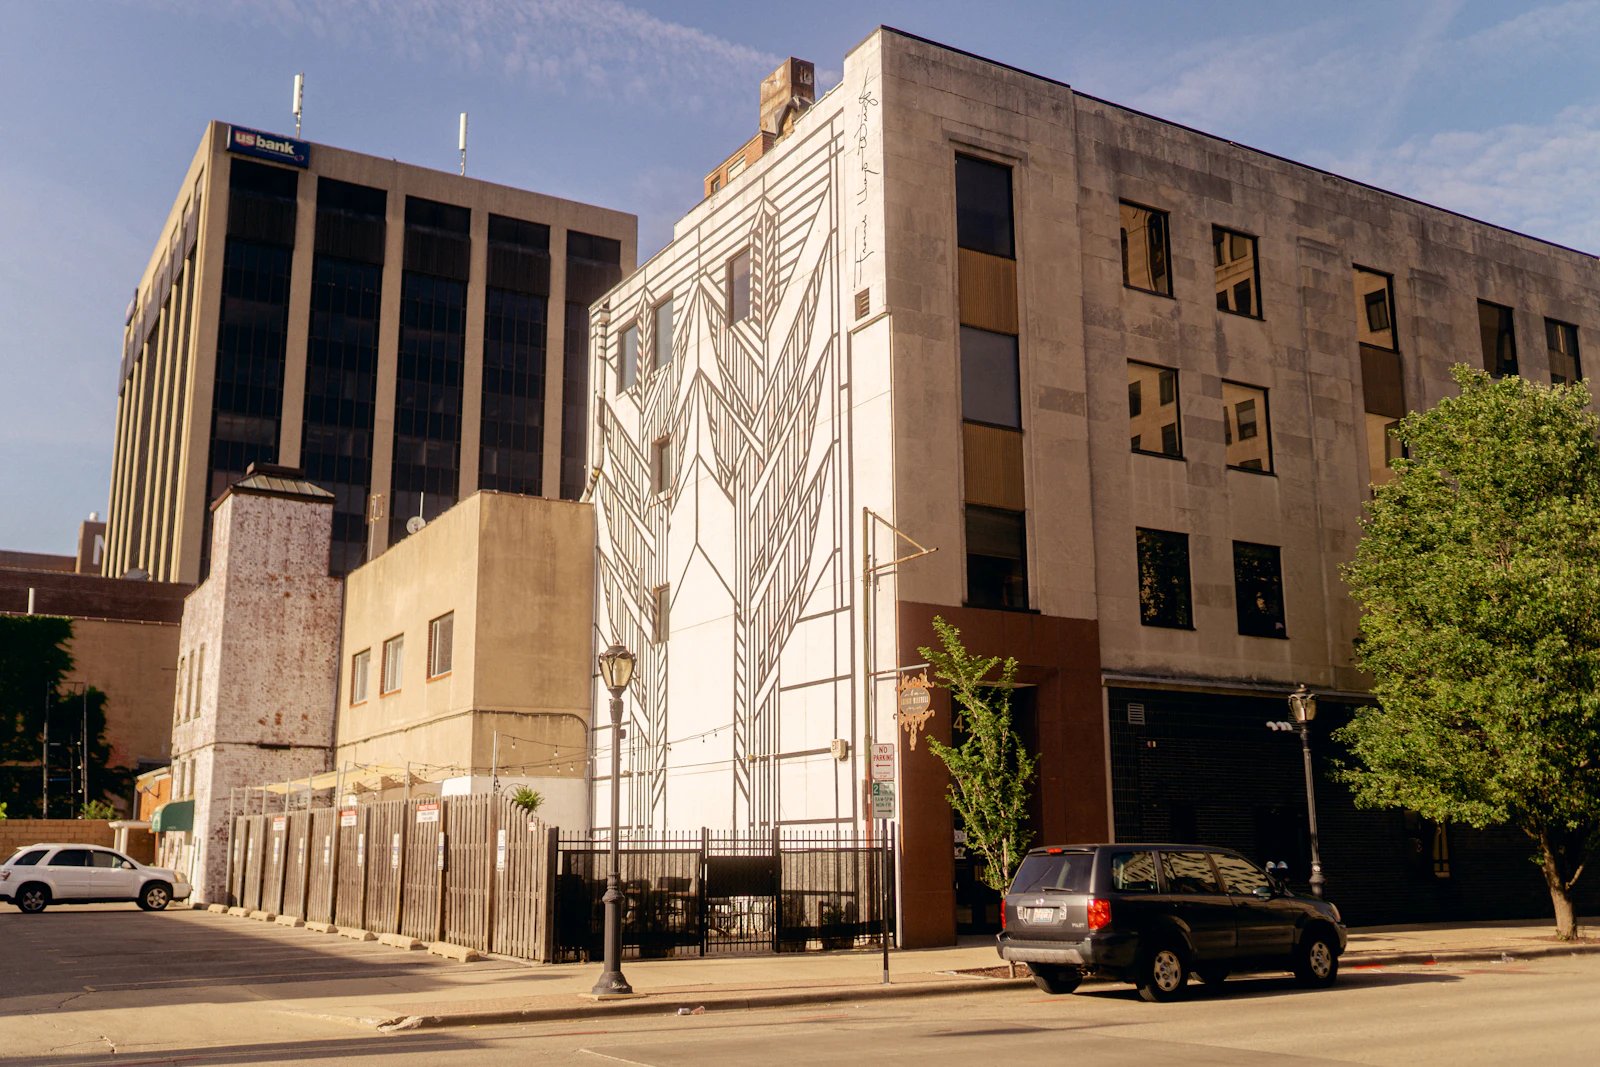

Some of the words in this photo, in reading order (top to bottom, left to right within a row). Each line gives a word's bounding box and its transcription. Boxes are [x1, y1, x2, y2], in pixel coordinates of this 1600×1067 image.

[878, 746, 888, 754] NO
[873, 754, 893, 762] PARKING
[873, 785, 879, 794] 2
